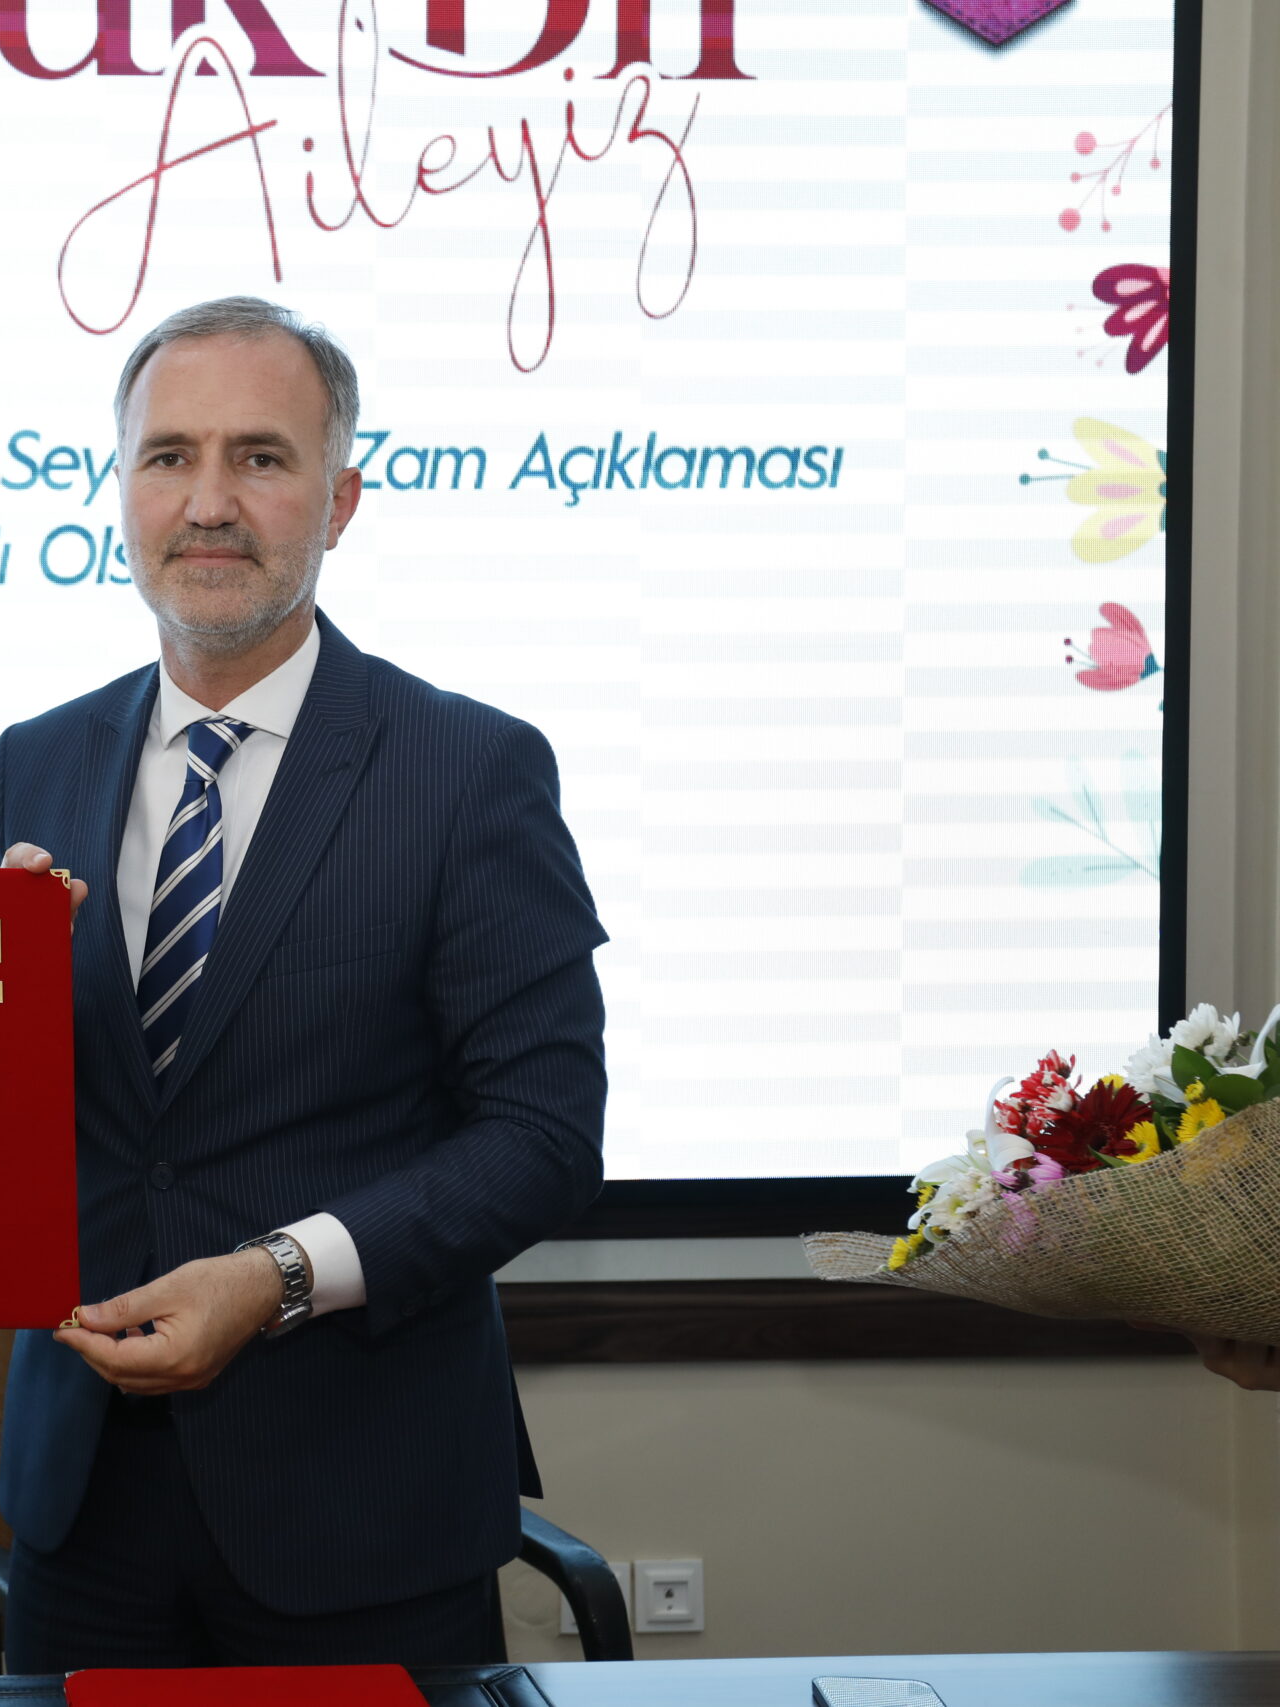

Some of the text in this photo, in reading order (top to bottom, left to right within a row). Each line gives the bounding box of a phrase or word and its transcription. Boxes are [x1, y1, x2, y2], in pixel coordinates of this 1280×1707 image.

[58, 0, 701, 373] Aileyiz
[354, 430, 487, 491] Zam
[508, 430, 842, 507] Açıklaması
[39, 524, 134, 586] Ols
